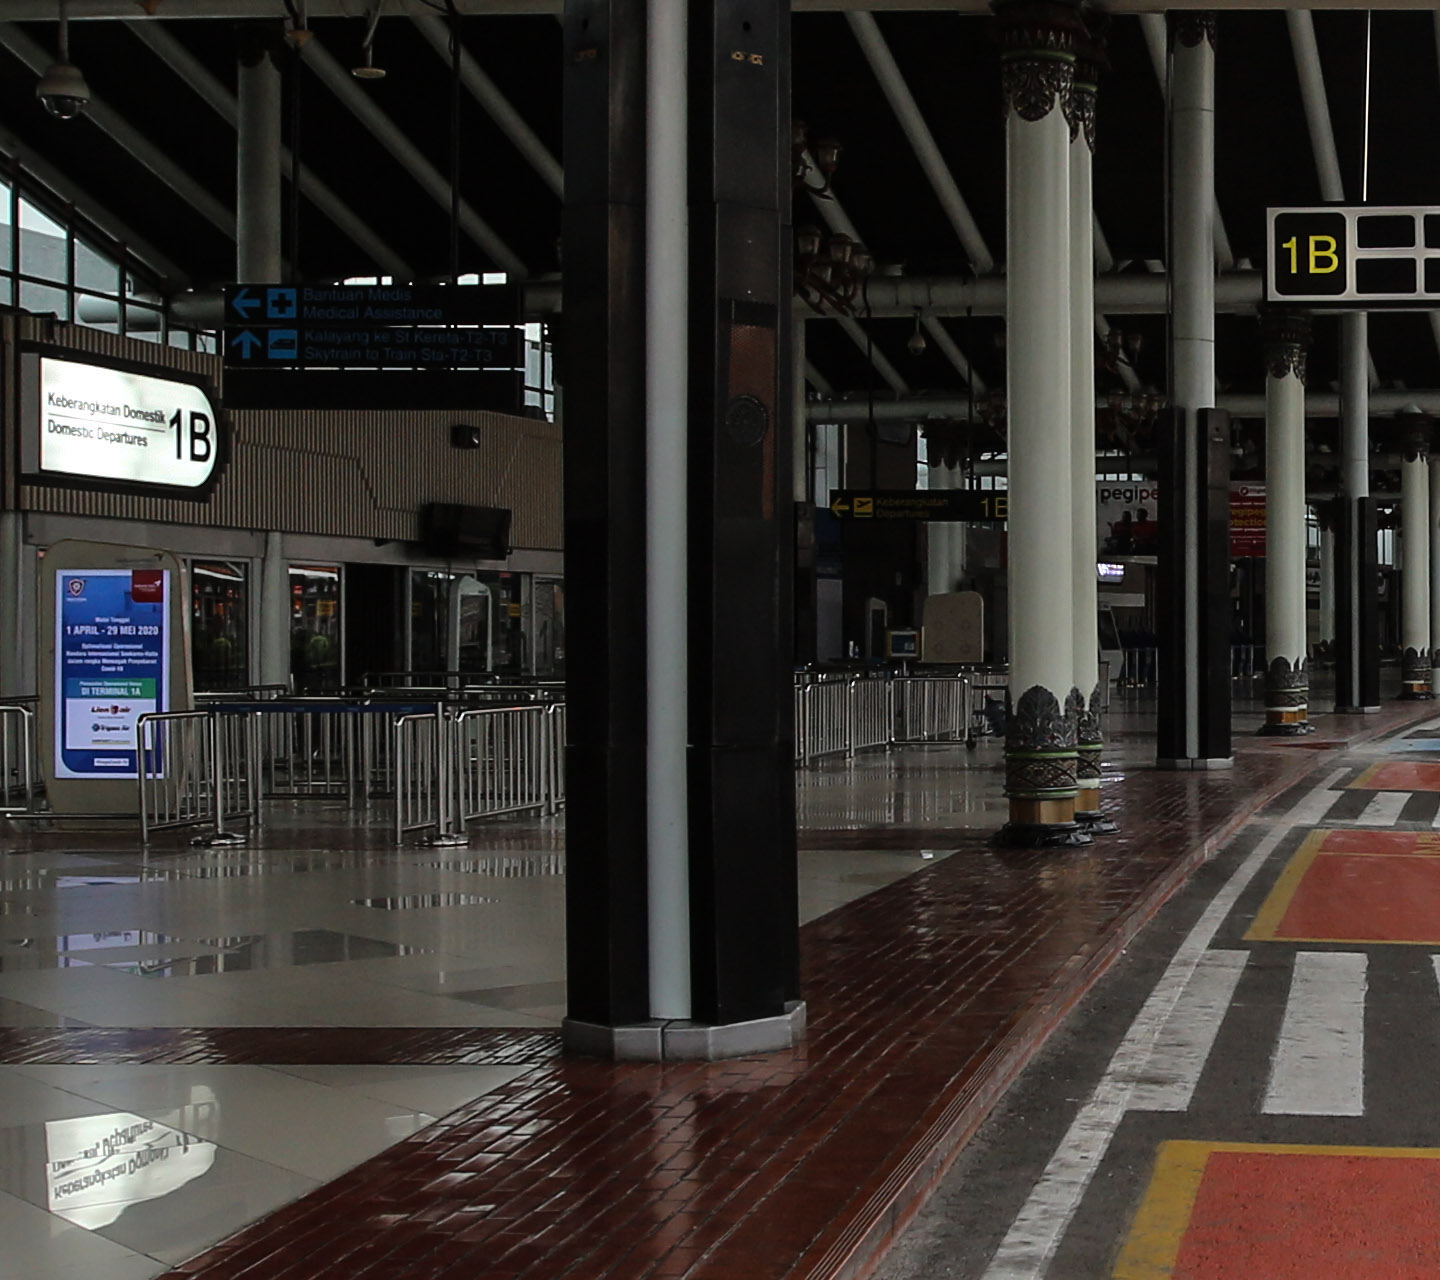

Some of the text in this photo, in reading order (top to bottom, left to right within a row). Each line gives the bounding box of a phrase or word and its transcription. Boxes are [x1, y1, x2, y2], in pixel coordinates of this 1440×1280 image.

[1282, 235, 1339, 275] 1B
[303, 288, 411, 303] Bantuan Medis
[303, 306, 443, 321] Medical Assistance
[304, 330, 370, 346] Kalayang
[374, 330, 391, 344] ke
[304, 347, 362, 364] Skytrain
[364, 348, 379, 361] to
[384, 347, 416, 361] Train
[48, 391, 166, 424] Keberangkatan Domestik
[48, 418, 148, 448] Domestic Departures
[168, 408, 212, 463] 1B
[980, 497, 1007, 518] 1B
[66, 626, 71, 635] 1
[73, 626, 100, 635] APRIL
[107, 626, 118, 635] 29
[119, 626, 136, 635] MEI
[138, 626, 159, 635] 2020
[81, 687, 141, 696] DI TERMINAL 1A
